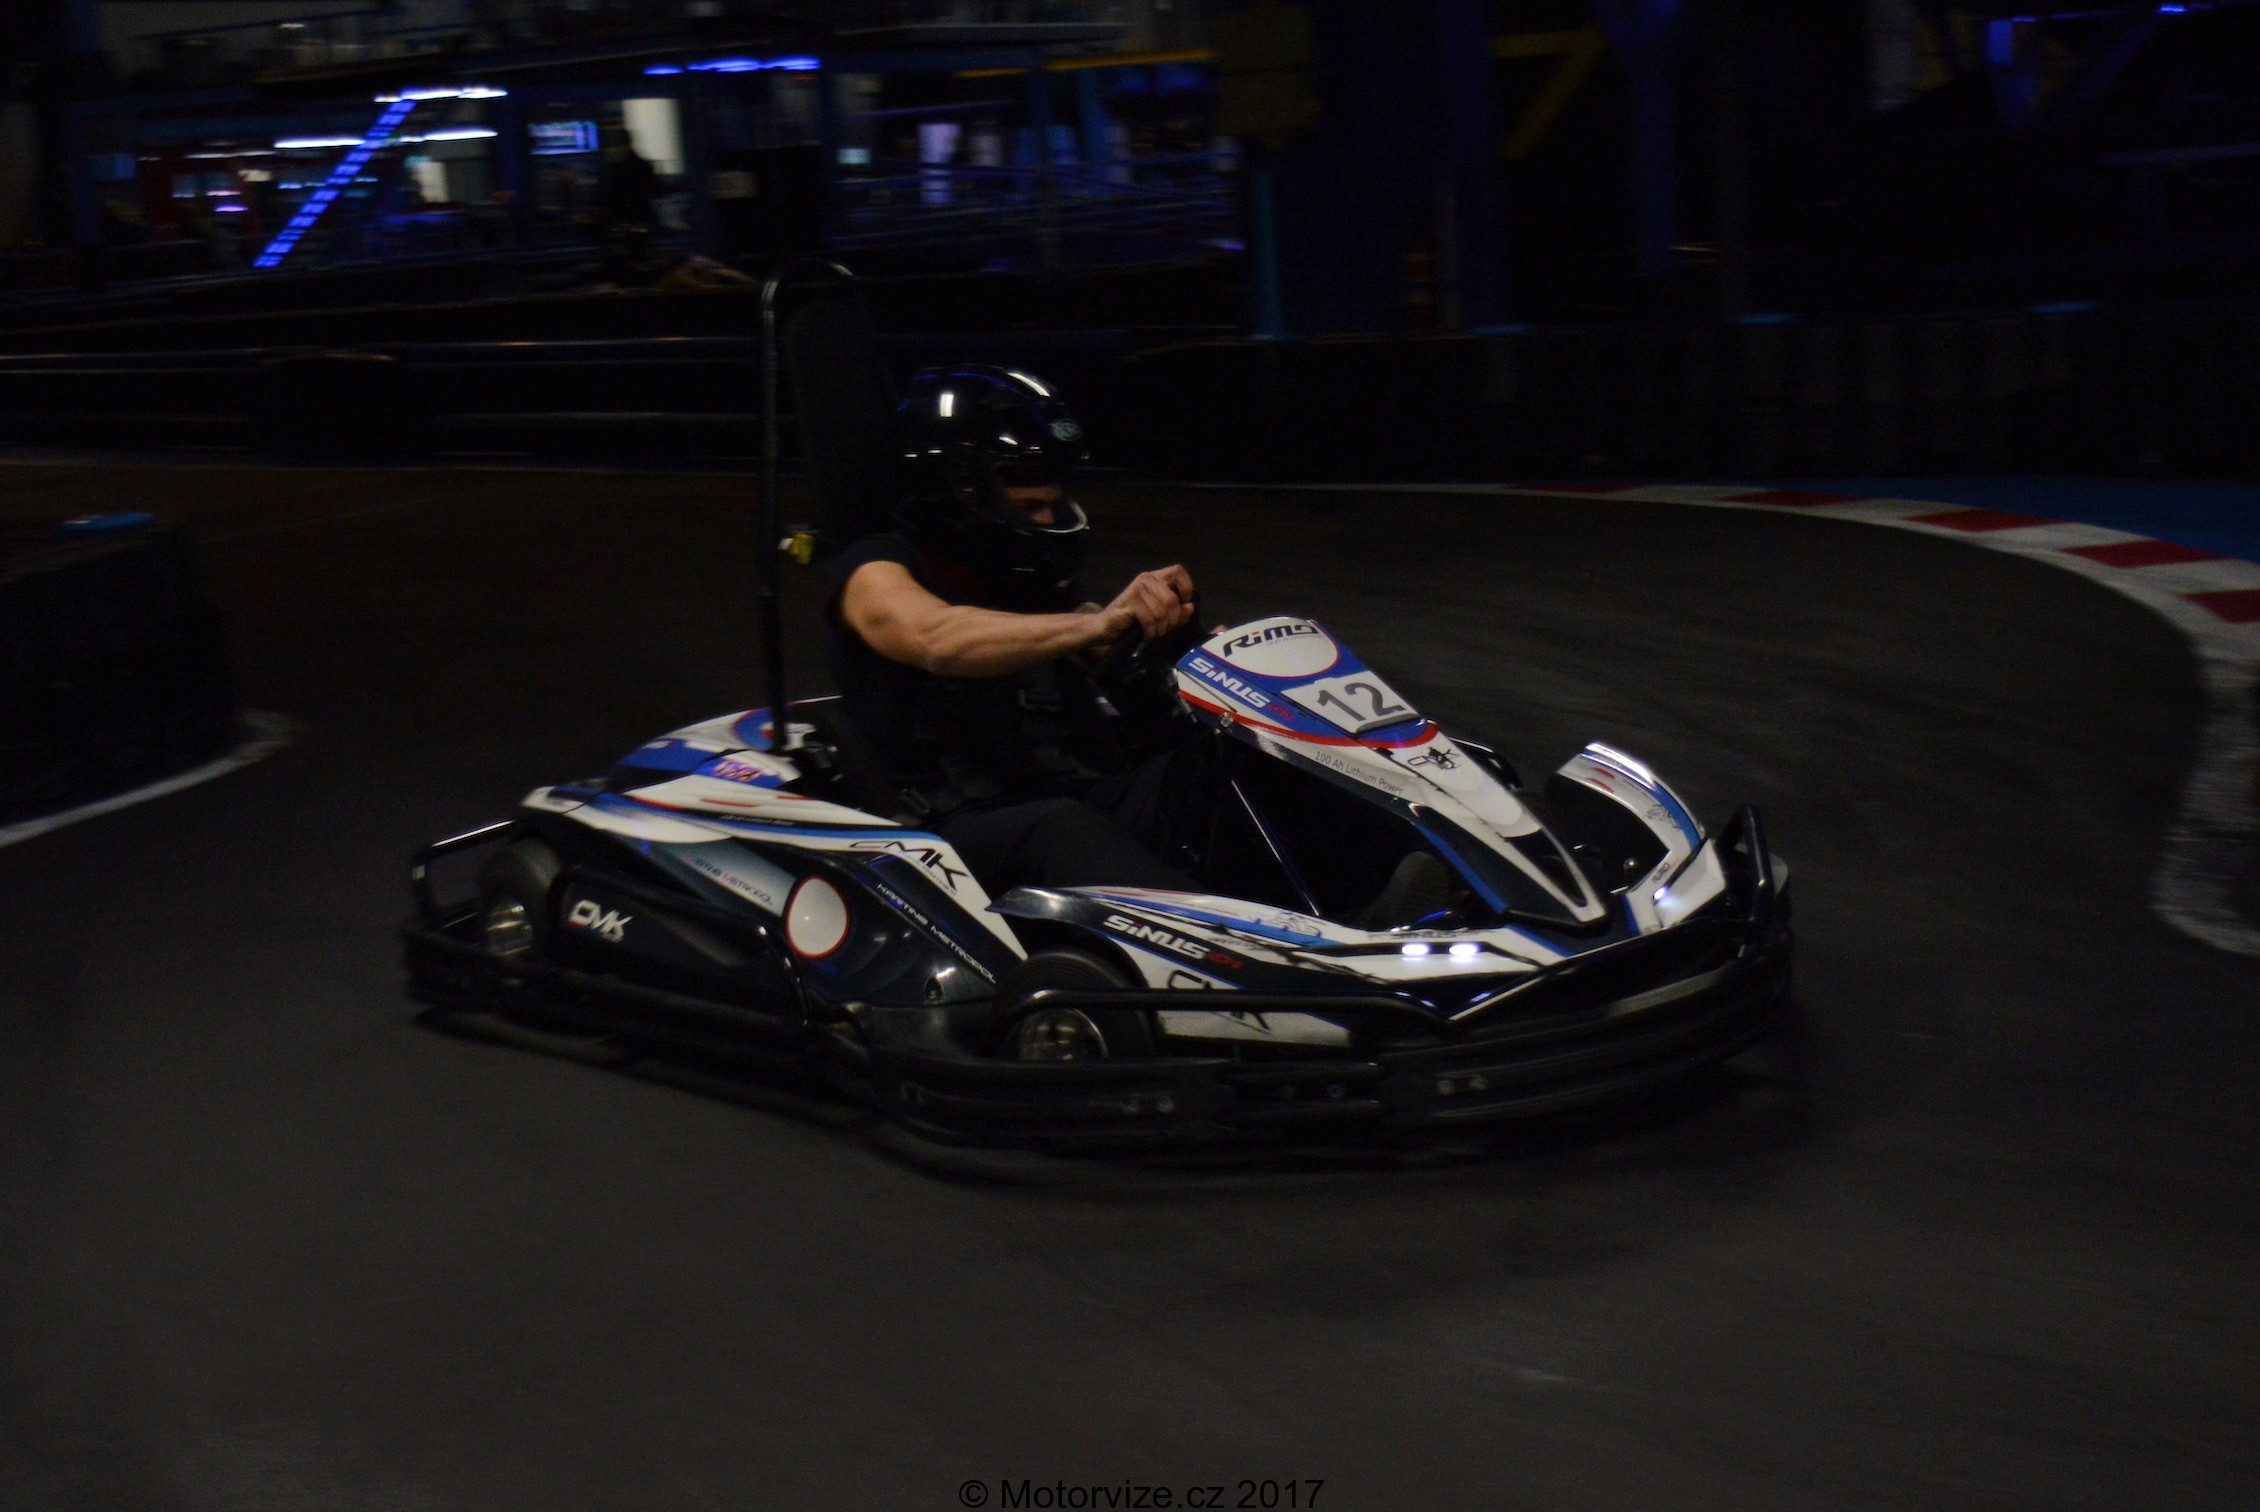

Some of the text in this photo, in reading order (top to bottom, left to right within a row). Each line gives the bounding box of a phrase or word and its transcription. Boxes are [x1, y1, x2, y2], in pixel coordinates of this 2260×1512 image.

[1317, 682, 1406, 721] 12
[1315, 751, 1405, 794] 100 Ah Lithium Power
